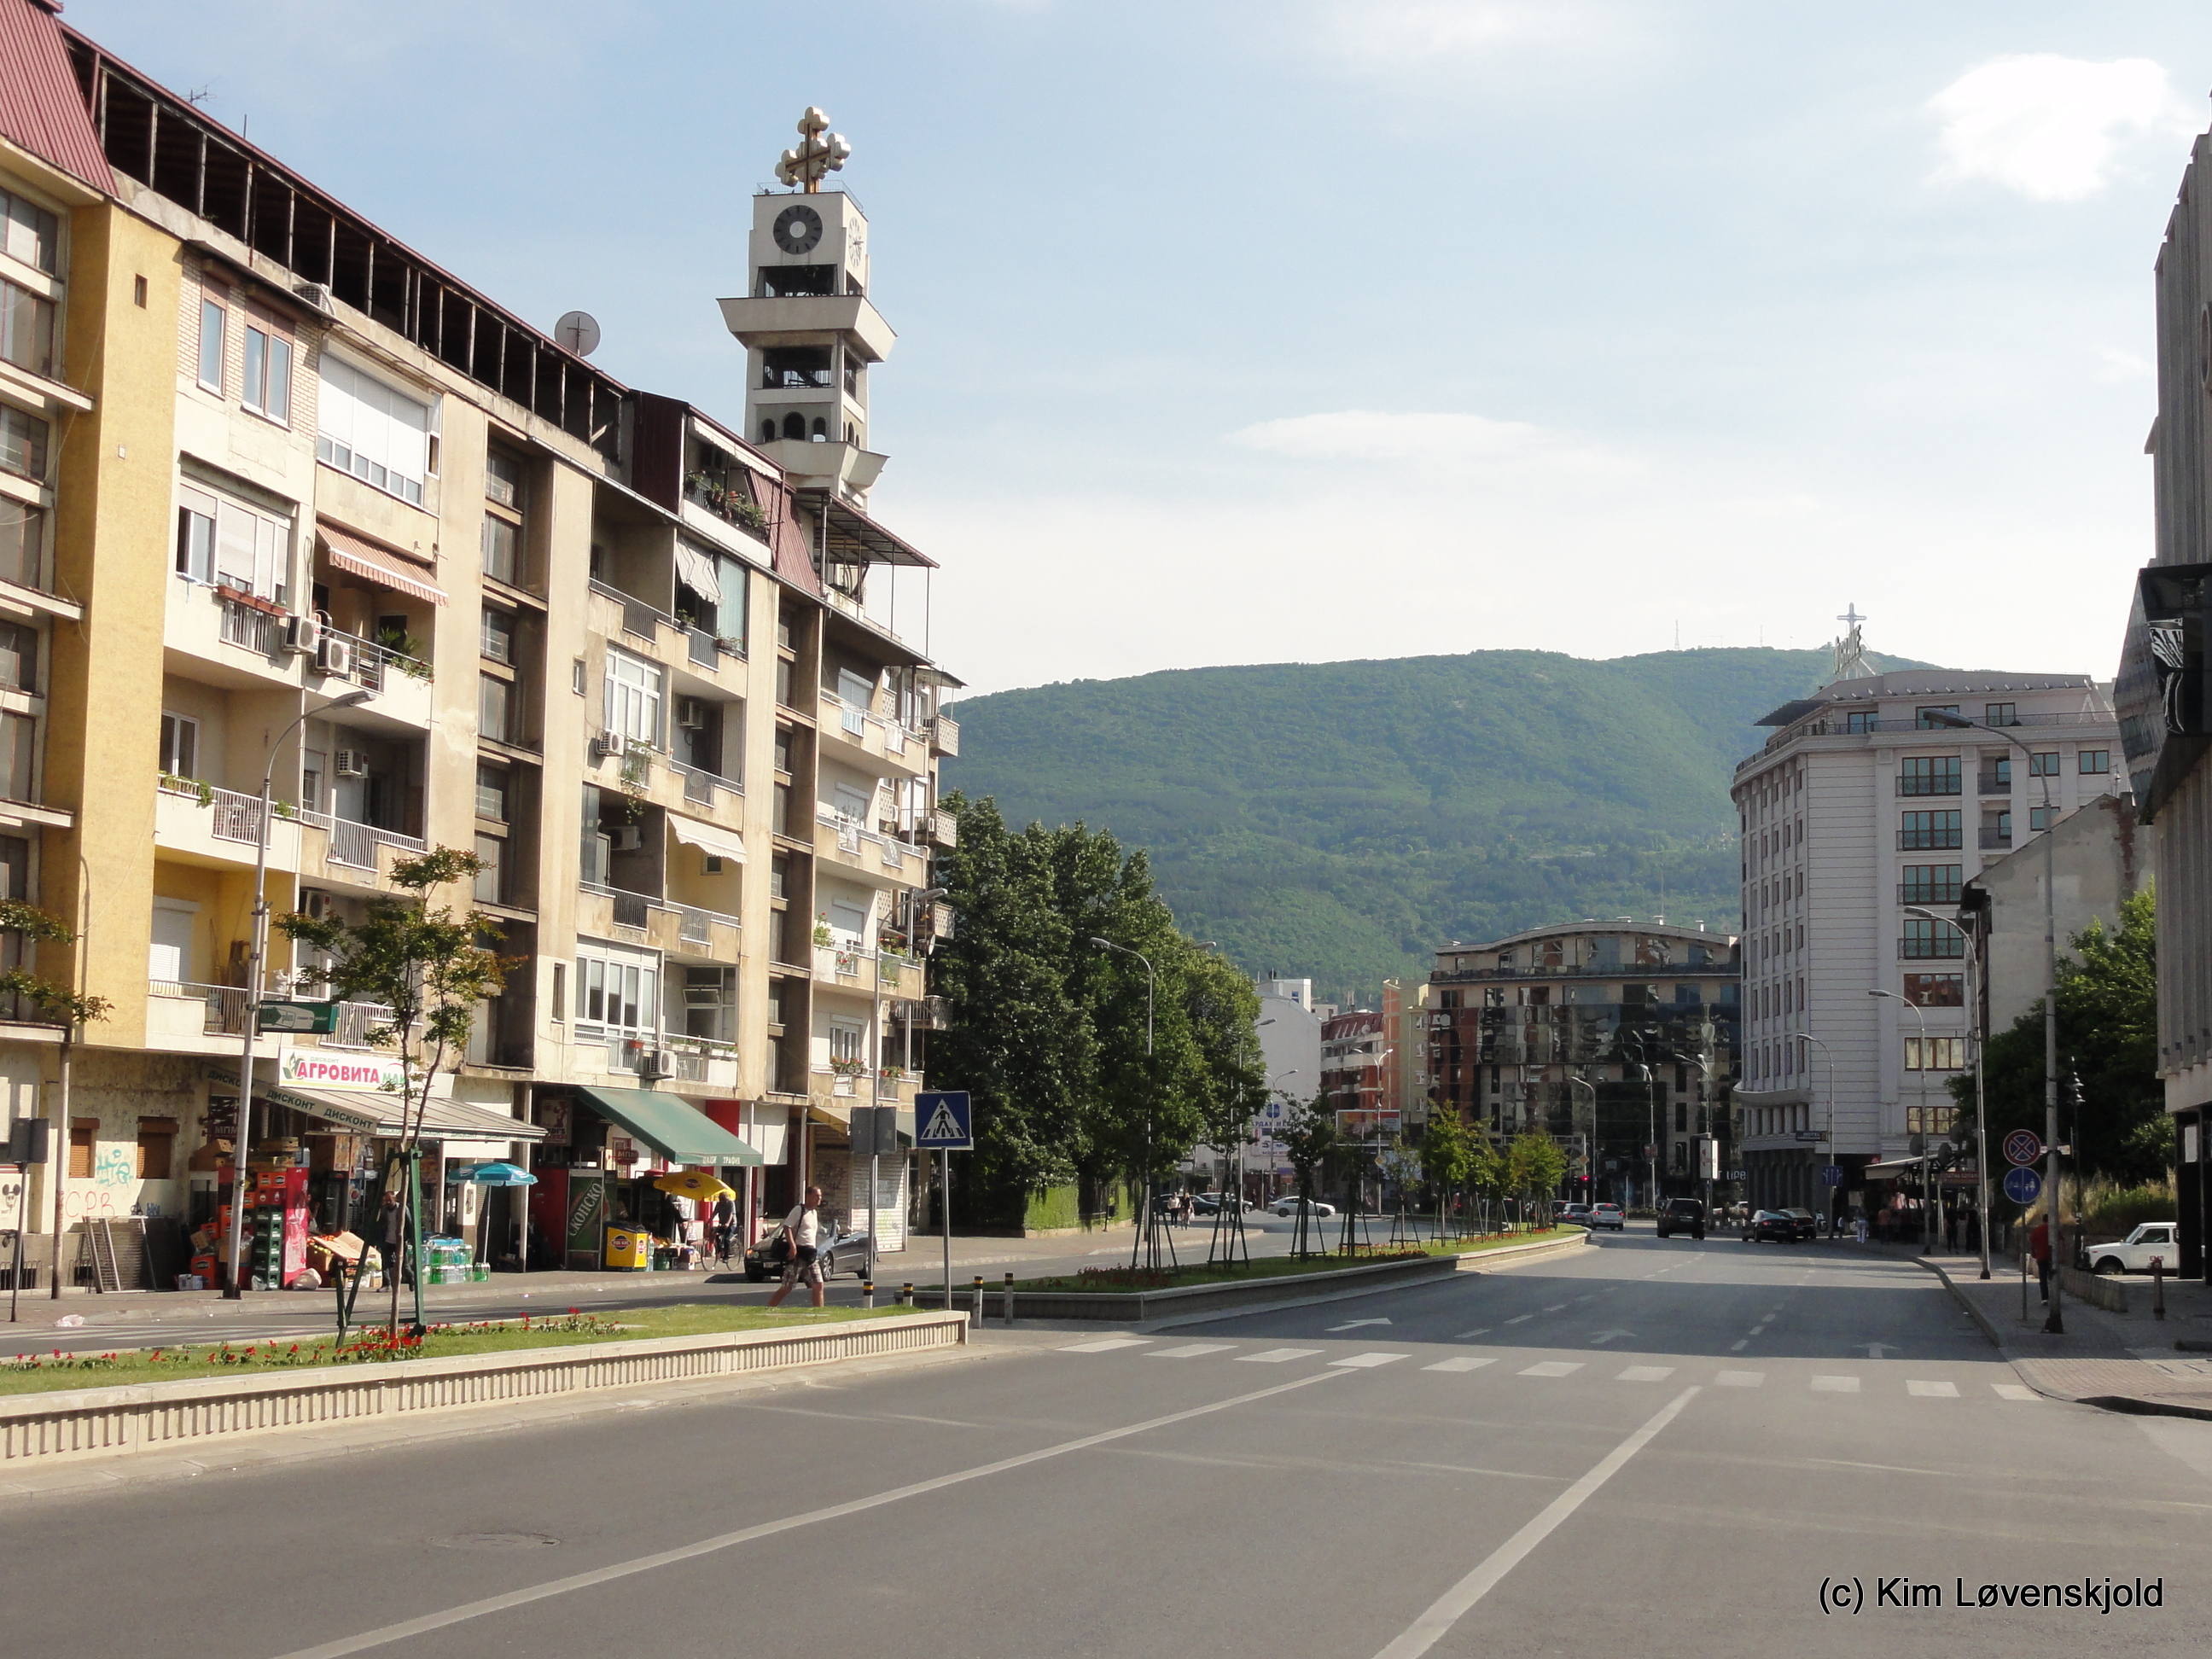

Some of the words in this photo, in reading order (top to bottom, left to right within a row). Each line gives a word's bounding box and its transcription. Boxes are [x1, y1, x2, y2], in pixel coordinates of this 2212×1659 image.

[207, 1070, 255, 1090] ДИСКО
[296, 1062, 380, 1084] АГРОВИТА
[266, 1090, 315, 1111] ДИСКОНТ
[323, 1108, 373, 1129] ДИСКОНТ
[568, 1183, 605, 1237] СКОПСКО
